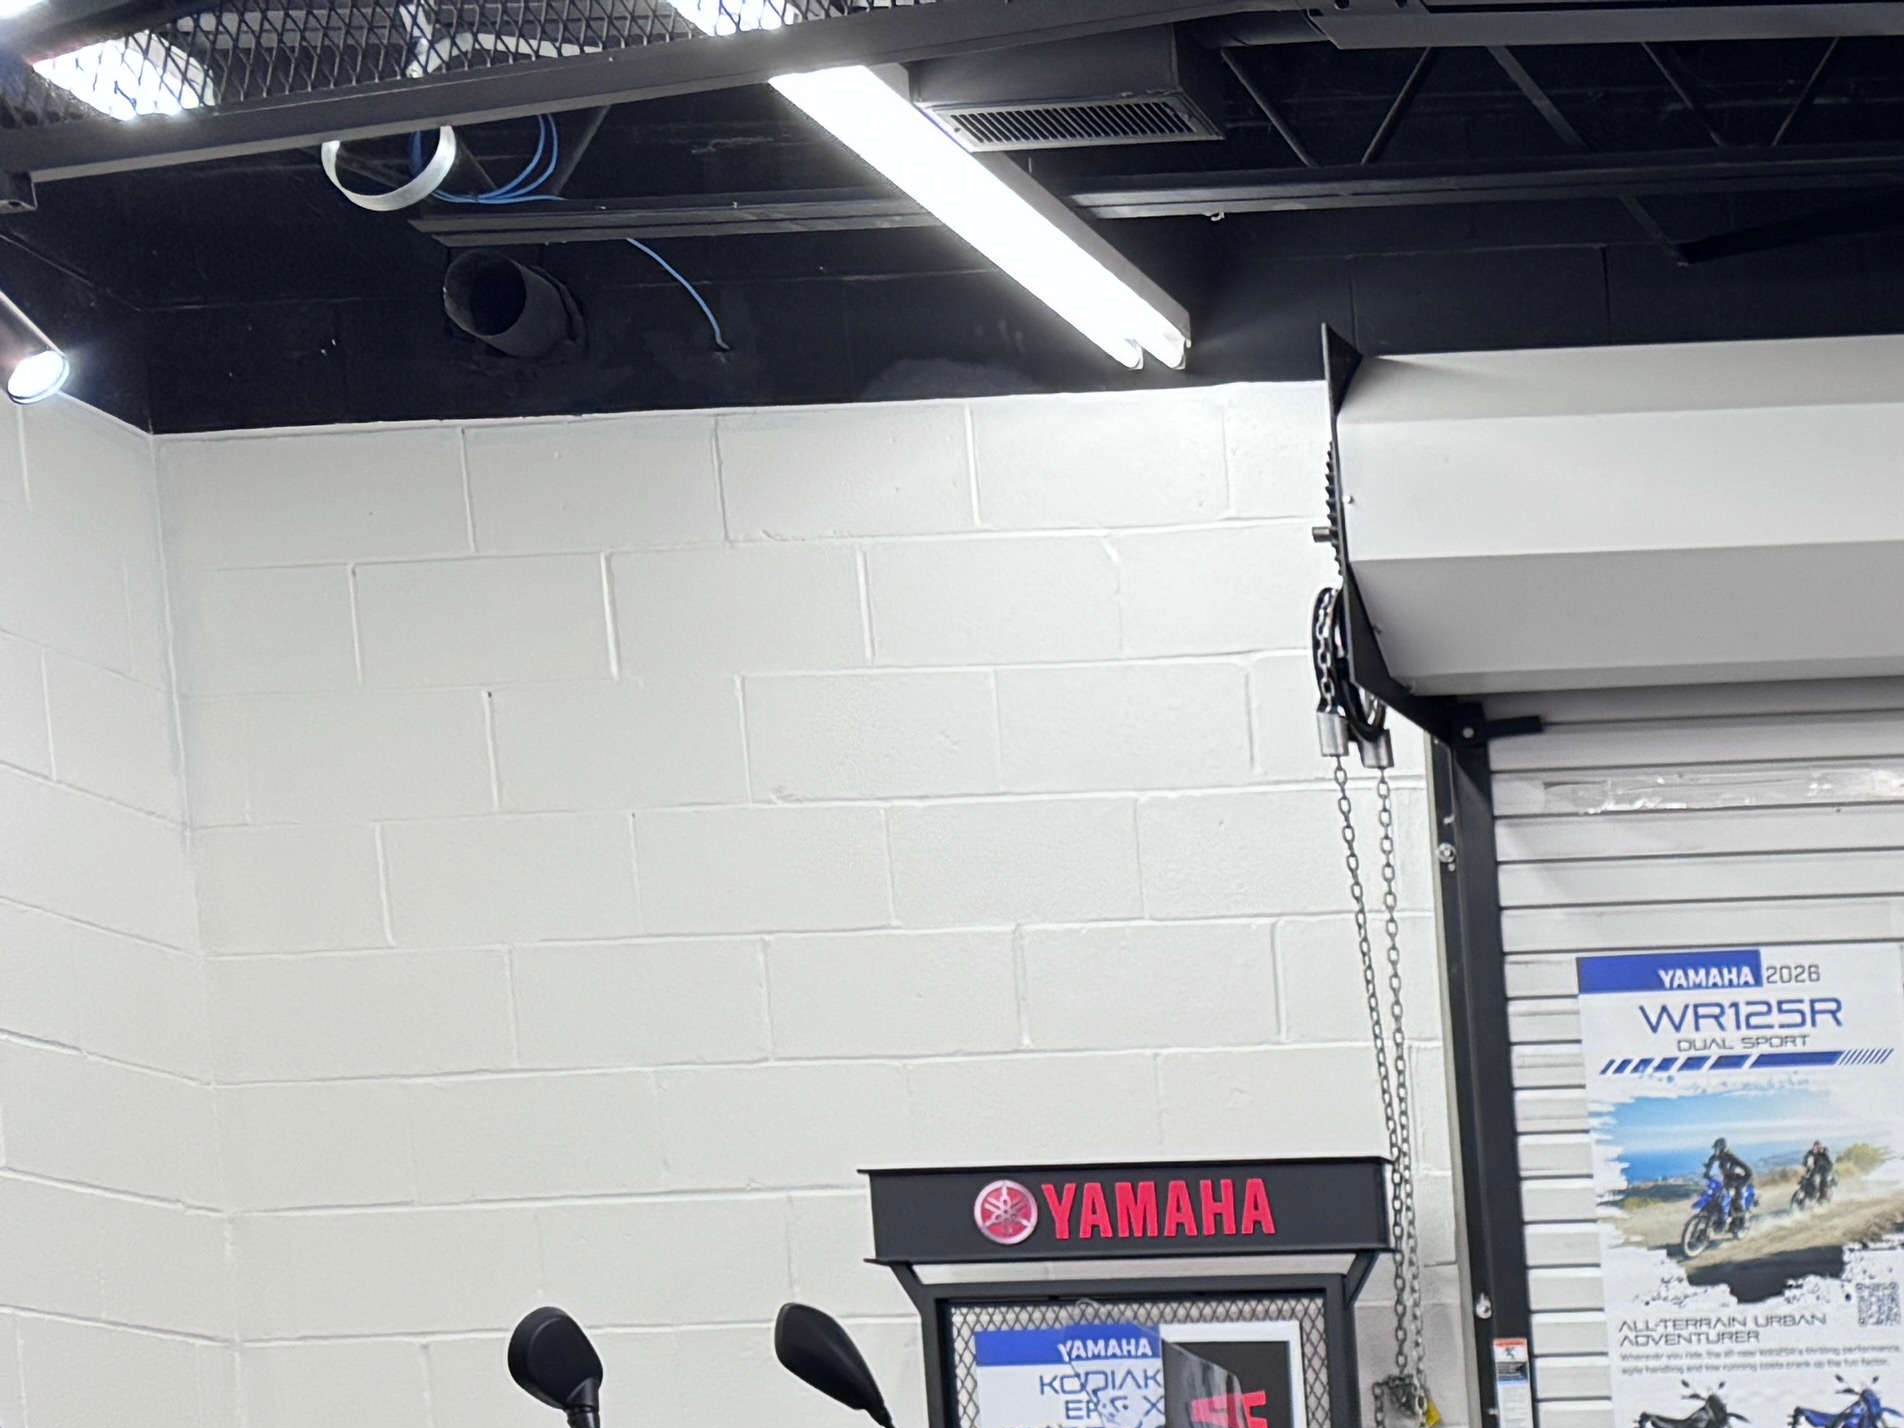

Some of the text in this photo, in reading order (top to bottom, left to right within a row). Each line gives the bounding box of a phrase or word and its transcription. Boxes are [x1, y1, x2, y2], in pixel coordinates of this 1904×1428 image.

[1658, 964, 1820, 989] YAMAHA 2026
[1638, 996, 1844, 1035] WR125R
[1677, 1034, 1811, 1053] DUAL SPORT
[1041, 1178, 1276, 1240] YAMAHA
[1618, 1312, 1827, 1334] ALL-TERRAIN URBAN
[1056, 1336, 1152, 1362] YAMAHA
[1620, 1330, 1760, 1347] ADVENTURER
